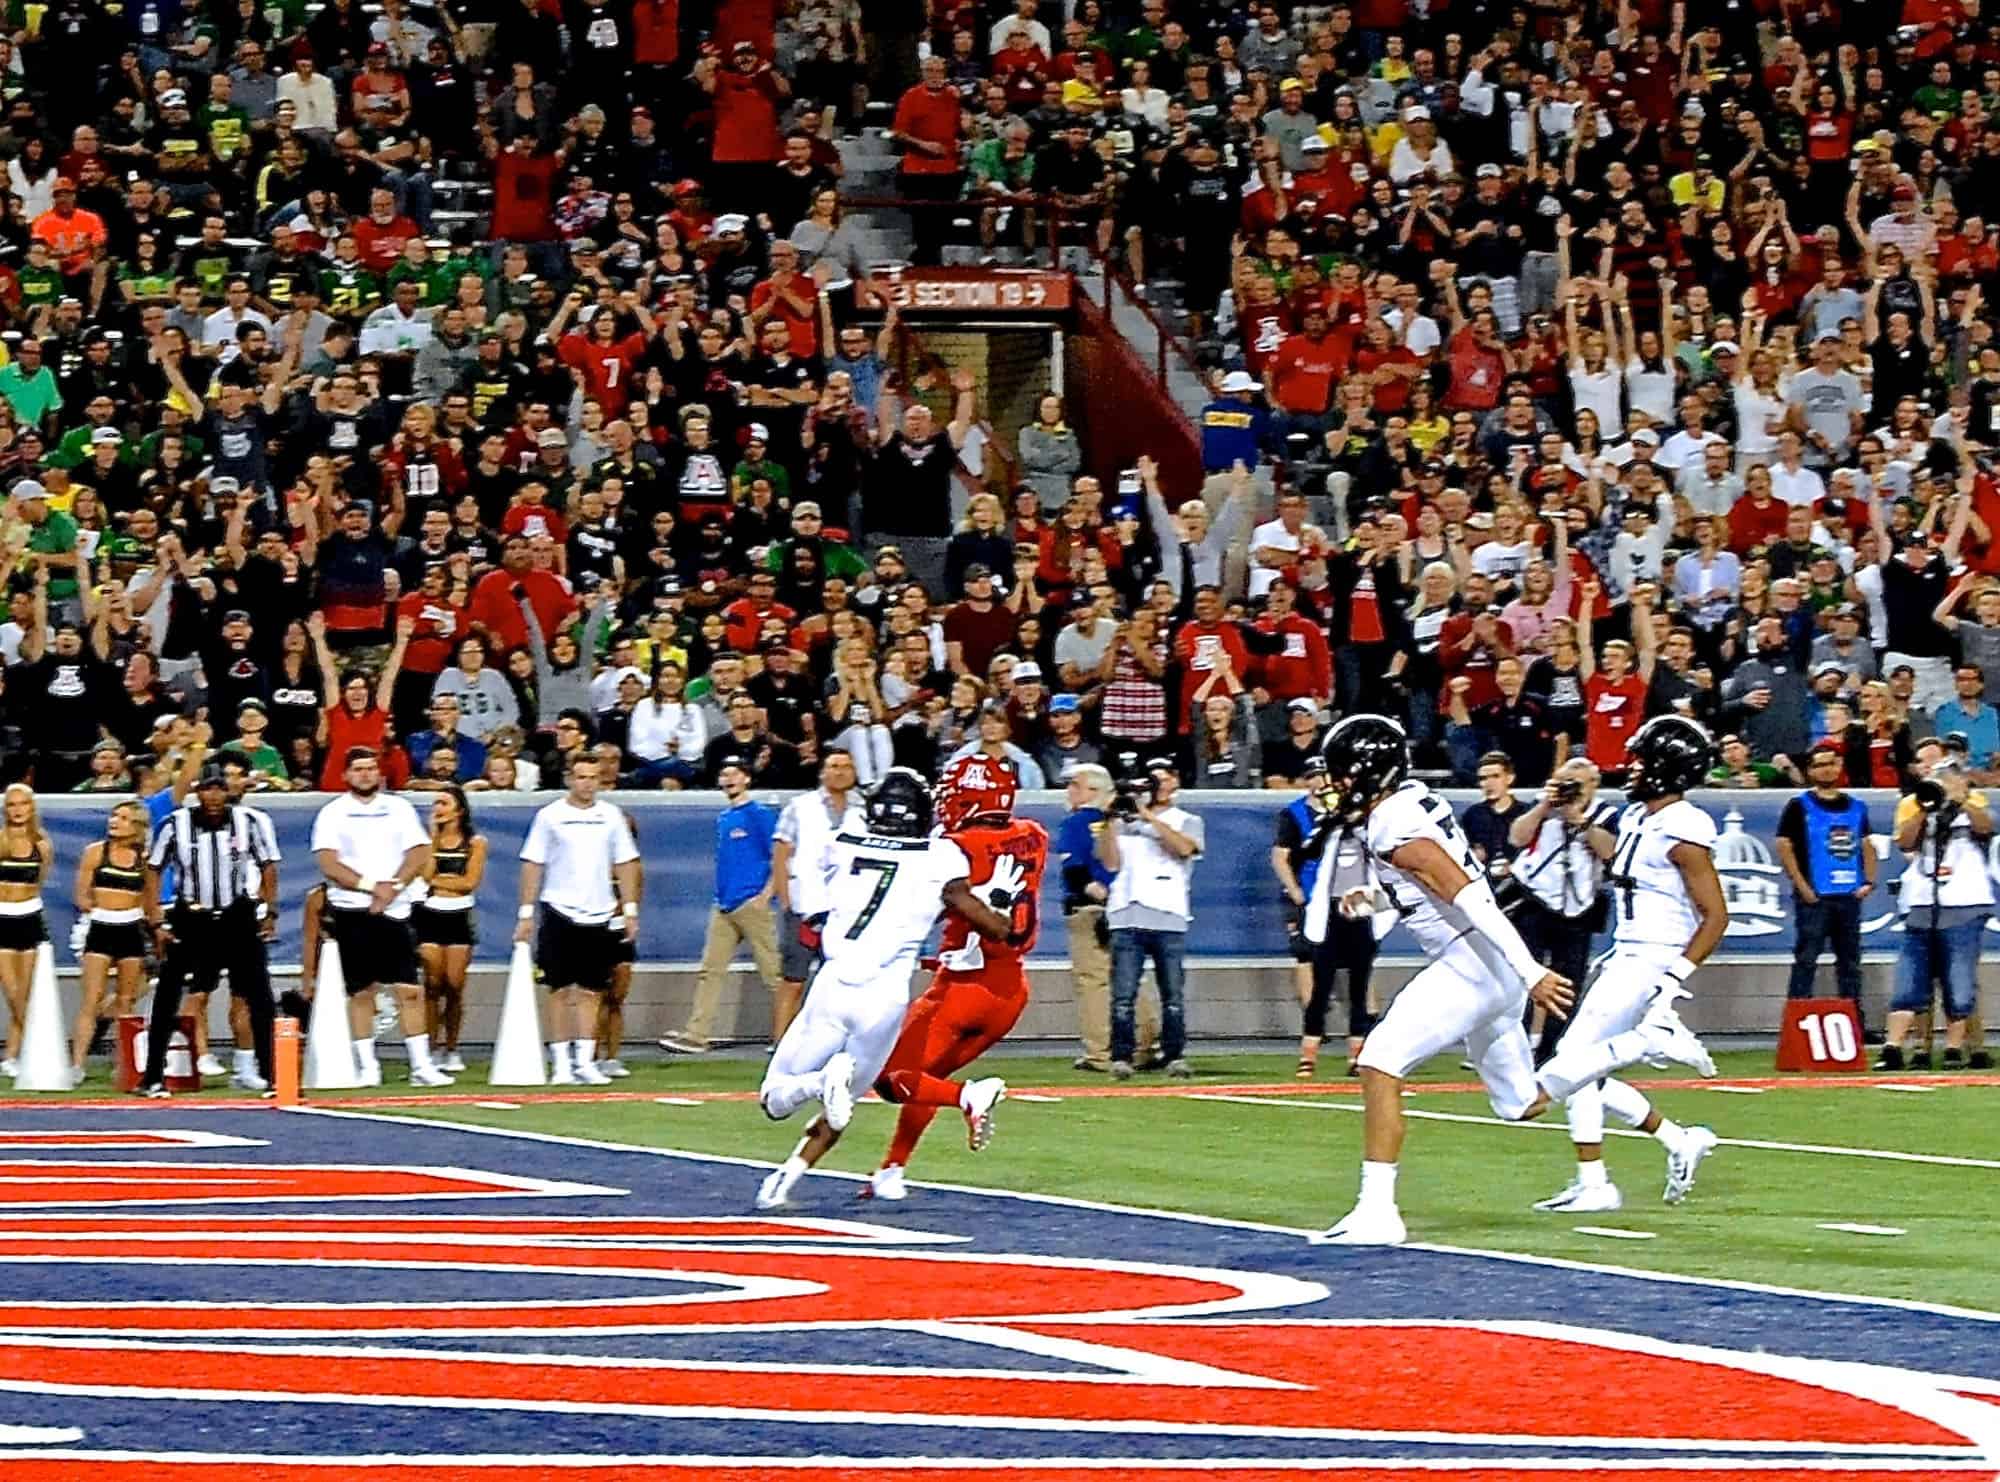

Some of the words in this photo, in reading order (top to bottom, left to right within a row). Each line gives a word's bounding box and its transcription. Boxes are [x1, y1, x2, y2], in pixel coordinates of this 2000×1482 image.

[915, 281, 997, 306] SECTION
[602, 357, 621, 388] 7
[844, 856, 899, 940] 7
[1798, 1012, 1858, 1062] 10
